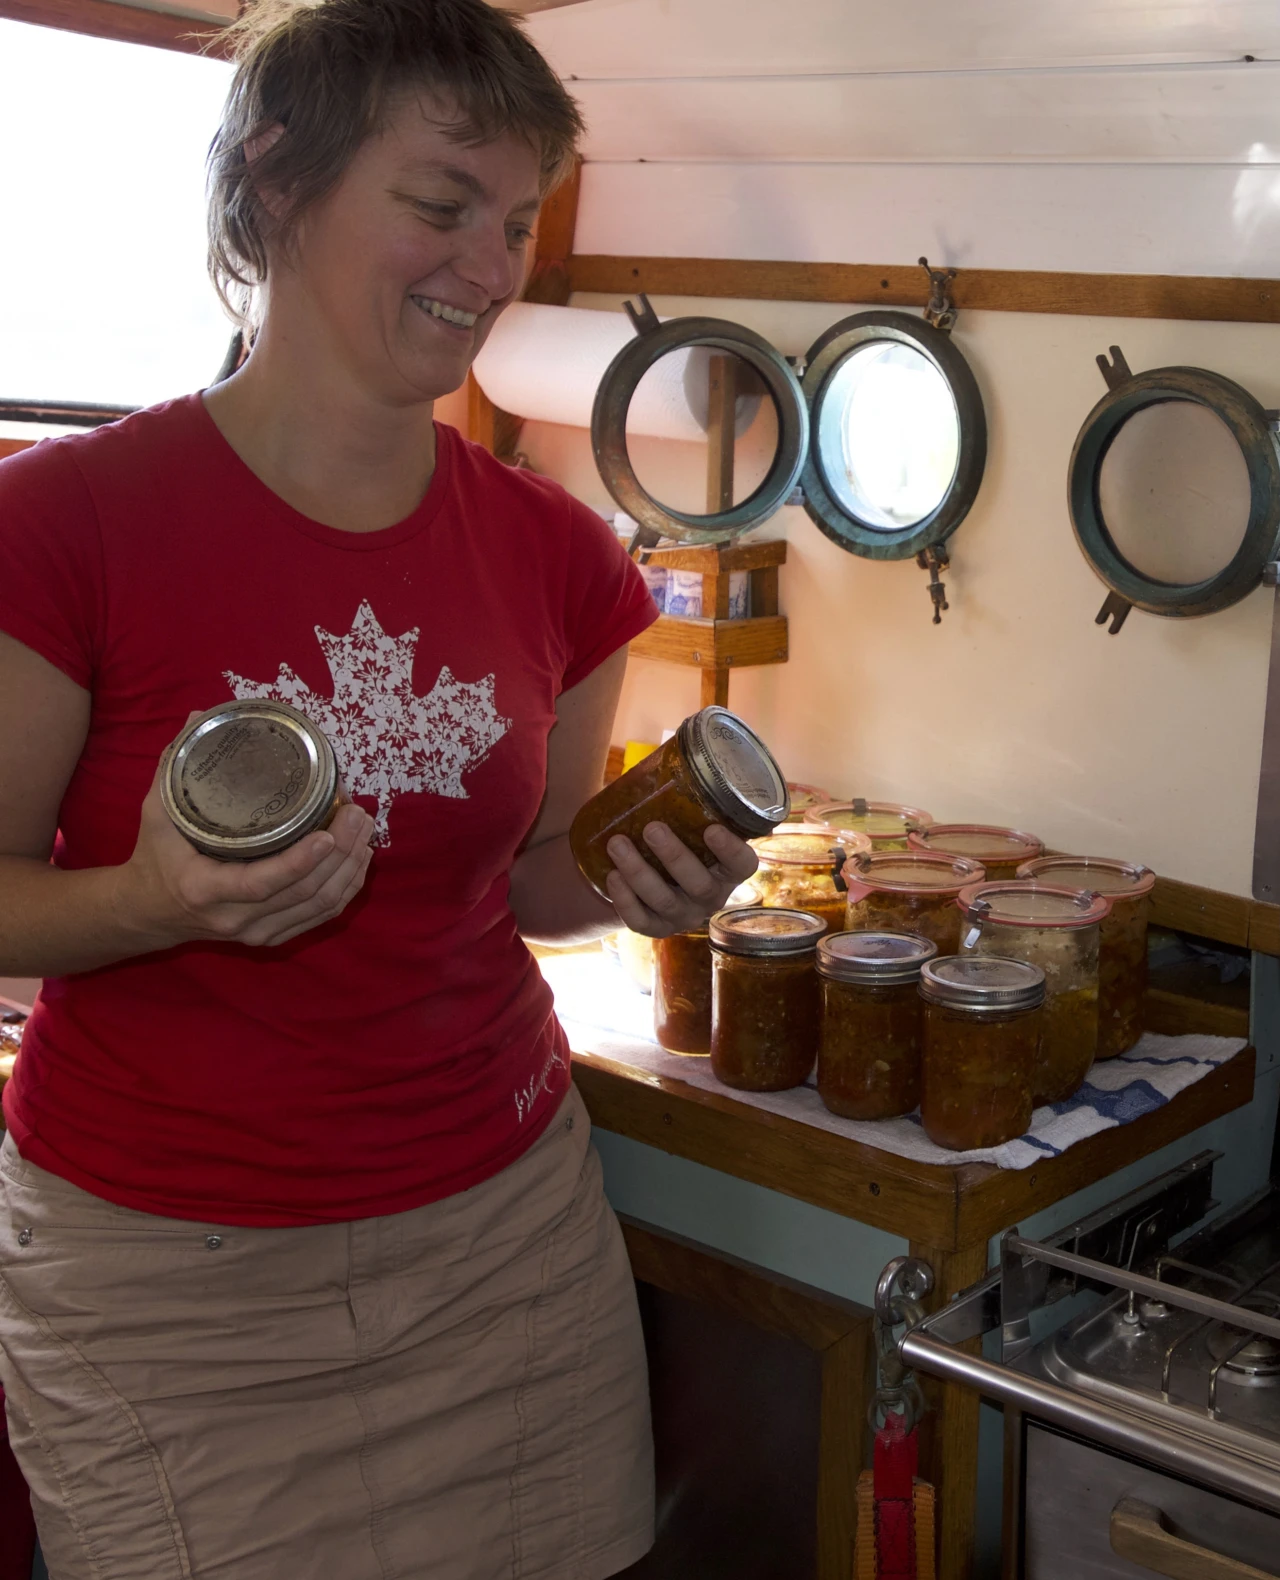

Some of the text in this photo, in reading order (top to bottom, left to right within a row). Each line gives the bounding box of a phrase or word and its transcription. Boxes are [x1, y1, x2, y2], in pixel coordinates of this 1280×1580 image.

[190, 753, 214, 776] crafted
[217, 724, 239, 749] quality
[194, 761, 217, 782] sealed
[218, 728, 247, 758] freshness
